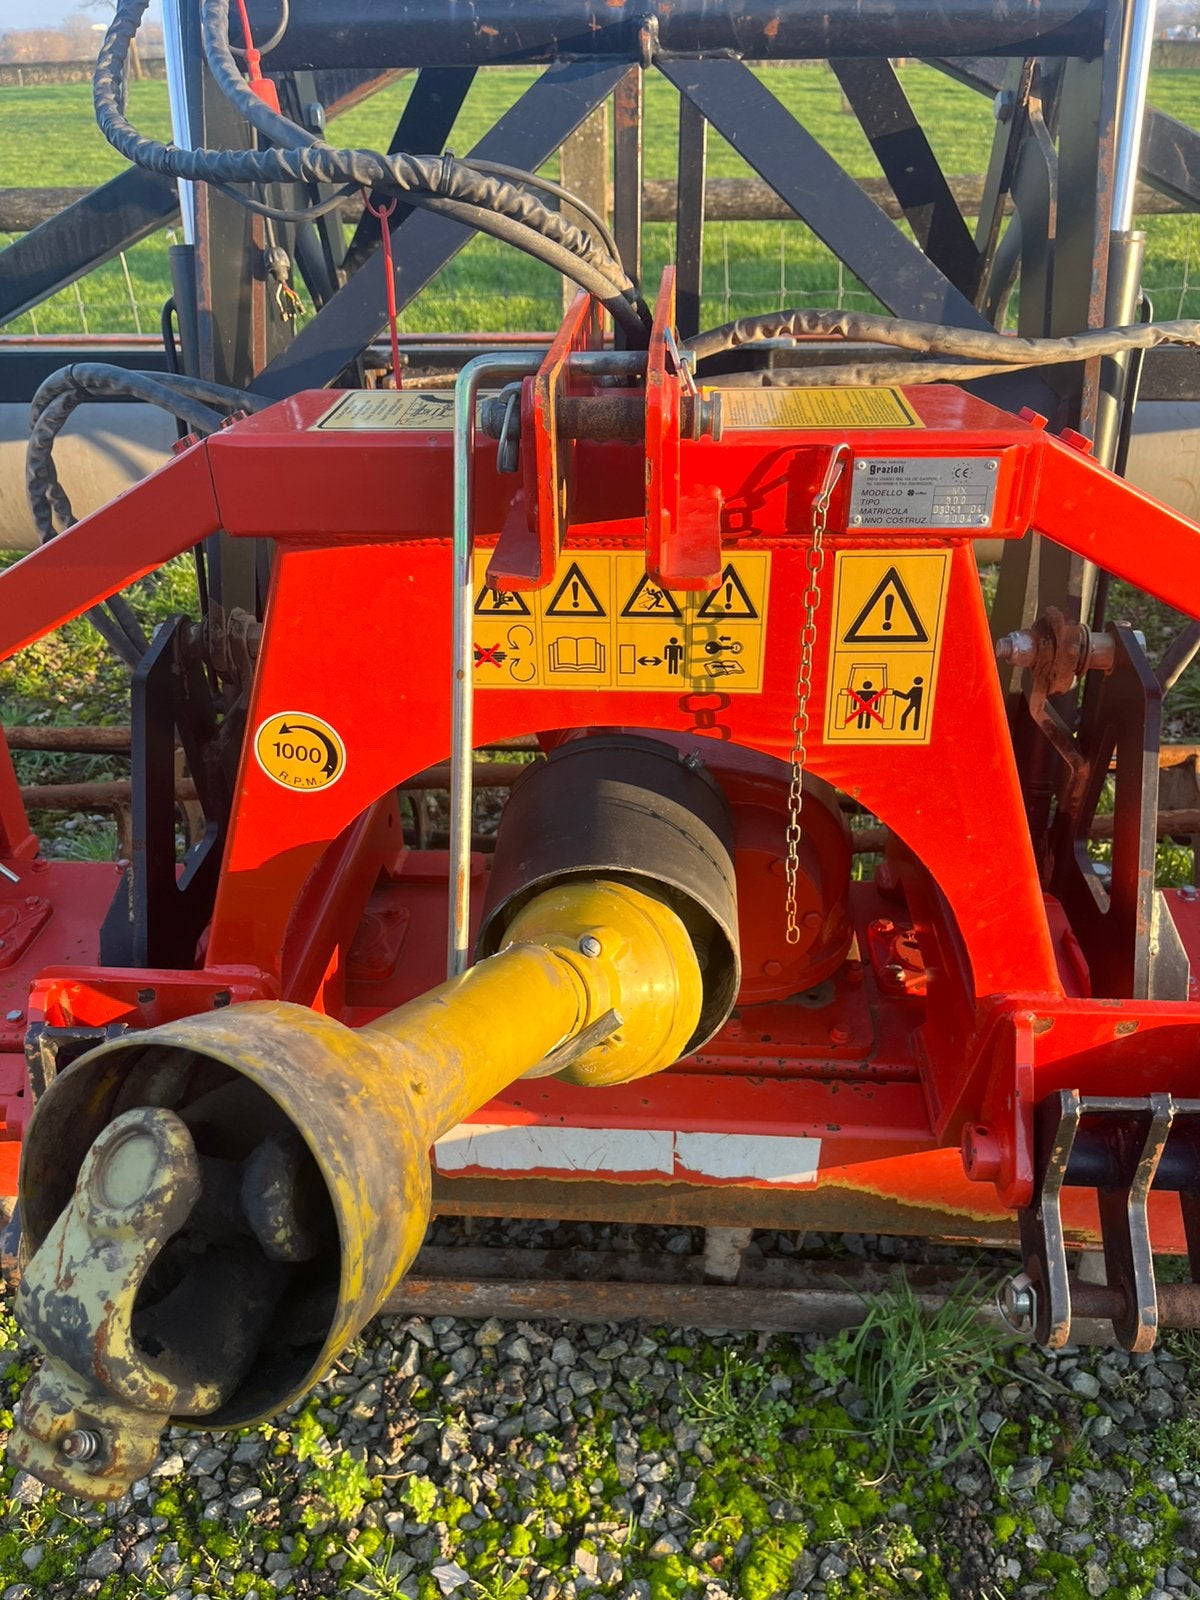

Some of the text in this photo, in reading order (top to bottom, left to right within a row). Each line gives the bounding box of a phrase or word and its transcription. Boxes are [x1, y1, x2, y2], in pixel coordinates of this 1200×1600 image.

[870, 465, 904, 475] grazioli
[955, 468, 969, 478] CE
[861, 489, 902, 497] MODELLO
[860, 496, 967, 506] TIPO 300
[859, 507, 908, 515] MATRICOLA
[970, 504, 982, 514] 04
[945, 514, 972, 523] 2004
[272, 742, 322, 764] 1000
[279, 771, 323, 786] R.P.M.
